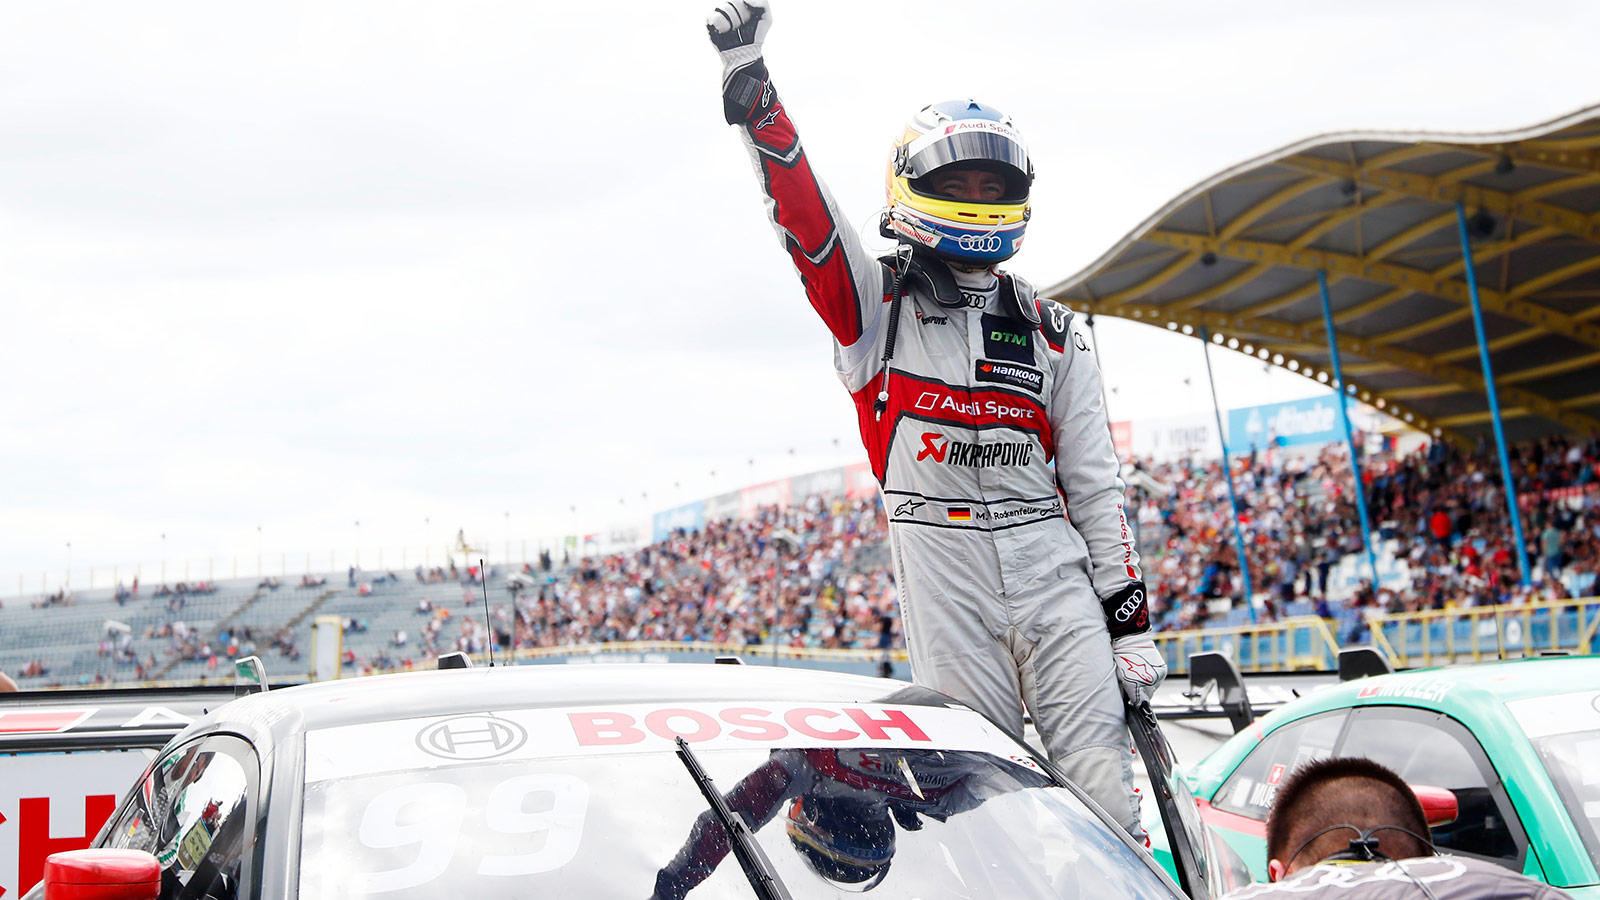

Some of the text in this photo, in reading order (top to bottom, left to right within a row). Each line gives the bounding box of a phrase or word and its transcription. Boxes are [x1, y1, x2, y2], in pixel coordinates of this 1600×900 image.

[990, 331, 1027, 346] DTM
[940, 396, 1035, 418] Audi Sport
[976, 506, 1041, 521] M. Rockenfeller
[1117, 503, 1132, 564] Aud Spot
[566, 707, 932, 747] BOSCH
[354, 773, 590, 895] 99
